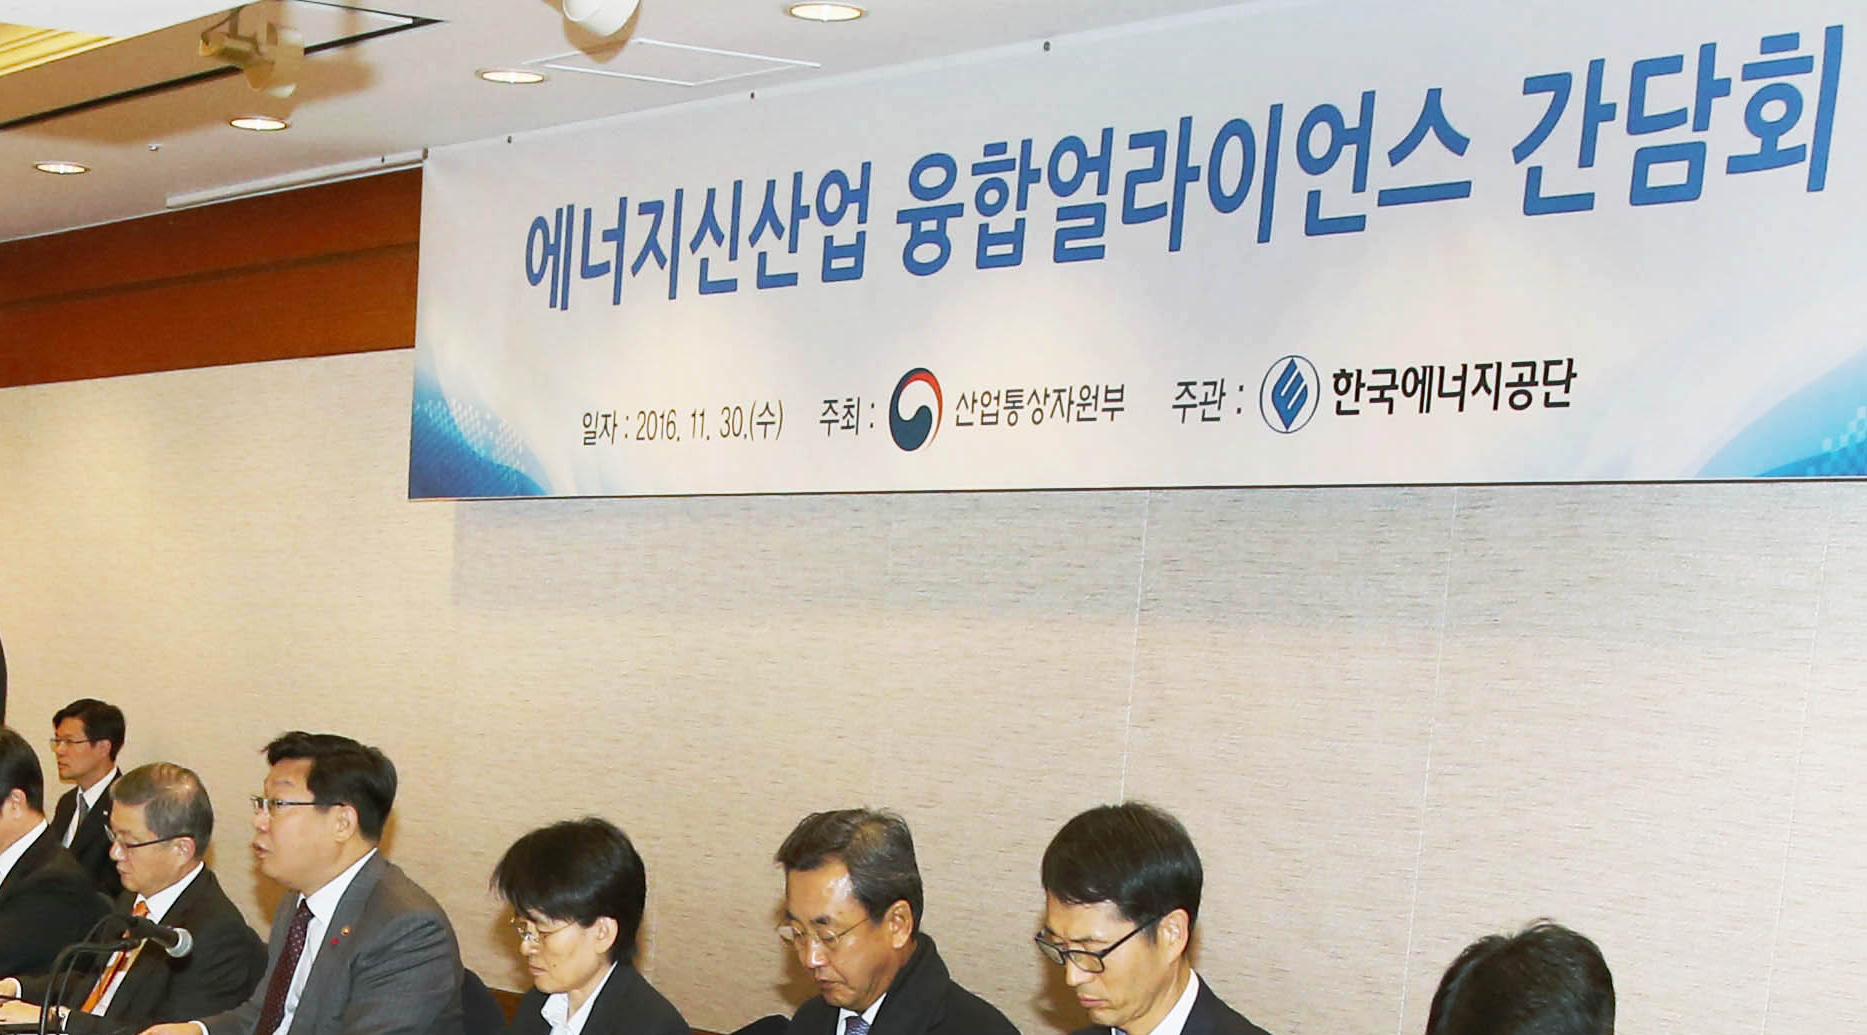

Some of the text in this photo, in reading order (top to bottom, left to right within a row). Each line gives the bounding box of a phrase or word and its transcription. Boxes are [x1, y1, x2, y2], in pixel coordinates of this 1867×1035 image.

[526, 24, 1844, 309] 에너지신산업 융합얼라이언스 간담회
[582, 410, 619, 446] 일자
[636, 409, 680, 441] 2016.
[819, 396, 861, 437] 주최
[955, 383, 1125, 427] 산업통상자원부
[1171, 378, 1227, 424] 주관
[1332, 357, 1578, 416] 한국에너지공단
